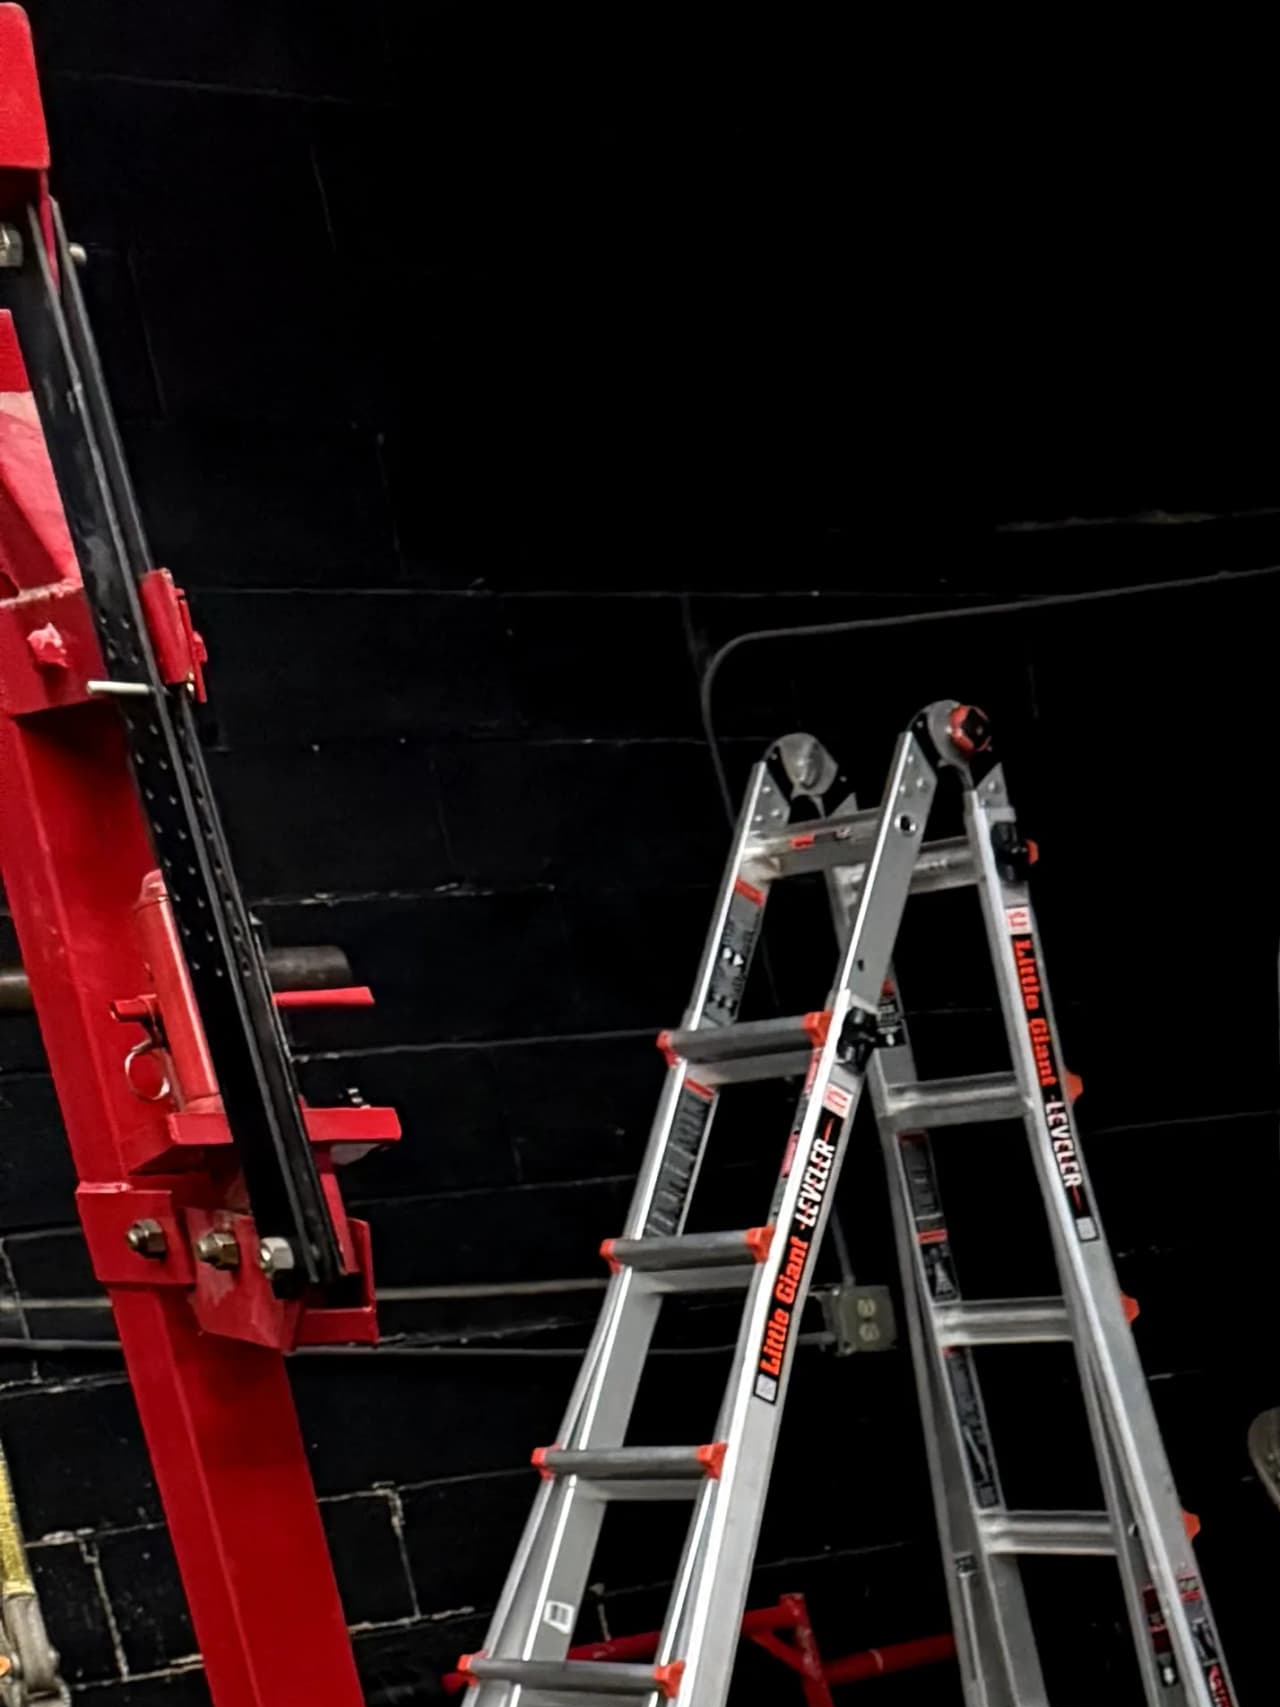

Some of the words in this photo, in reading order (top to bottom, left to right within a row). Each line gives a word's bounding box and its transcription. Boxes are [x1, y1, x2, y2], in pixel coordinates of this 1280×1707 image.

[1014, 938, 1042, 1010] Little
[1027, 1017, 1058, 1087] Giant
[1045, 1101, 1083, 1188] LEVELER
[794, 1138, 835, 1228] LEVELER
[774, 1235, 809, 1305] Giant
[759, 1307, 790, 1376] Little
